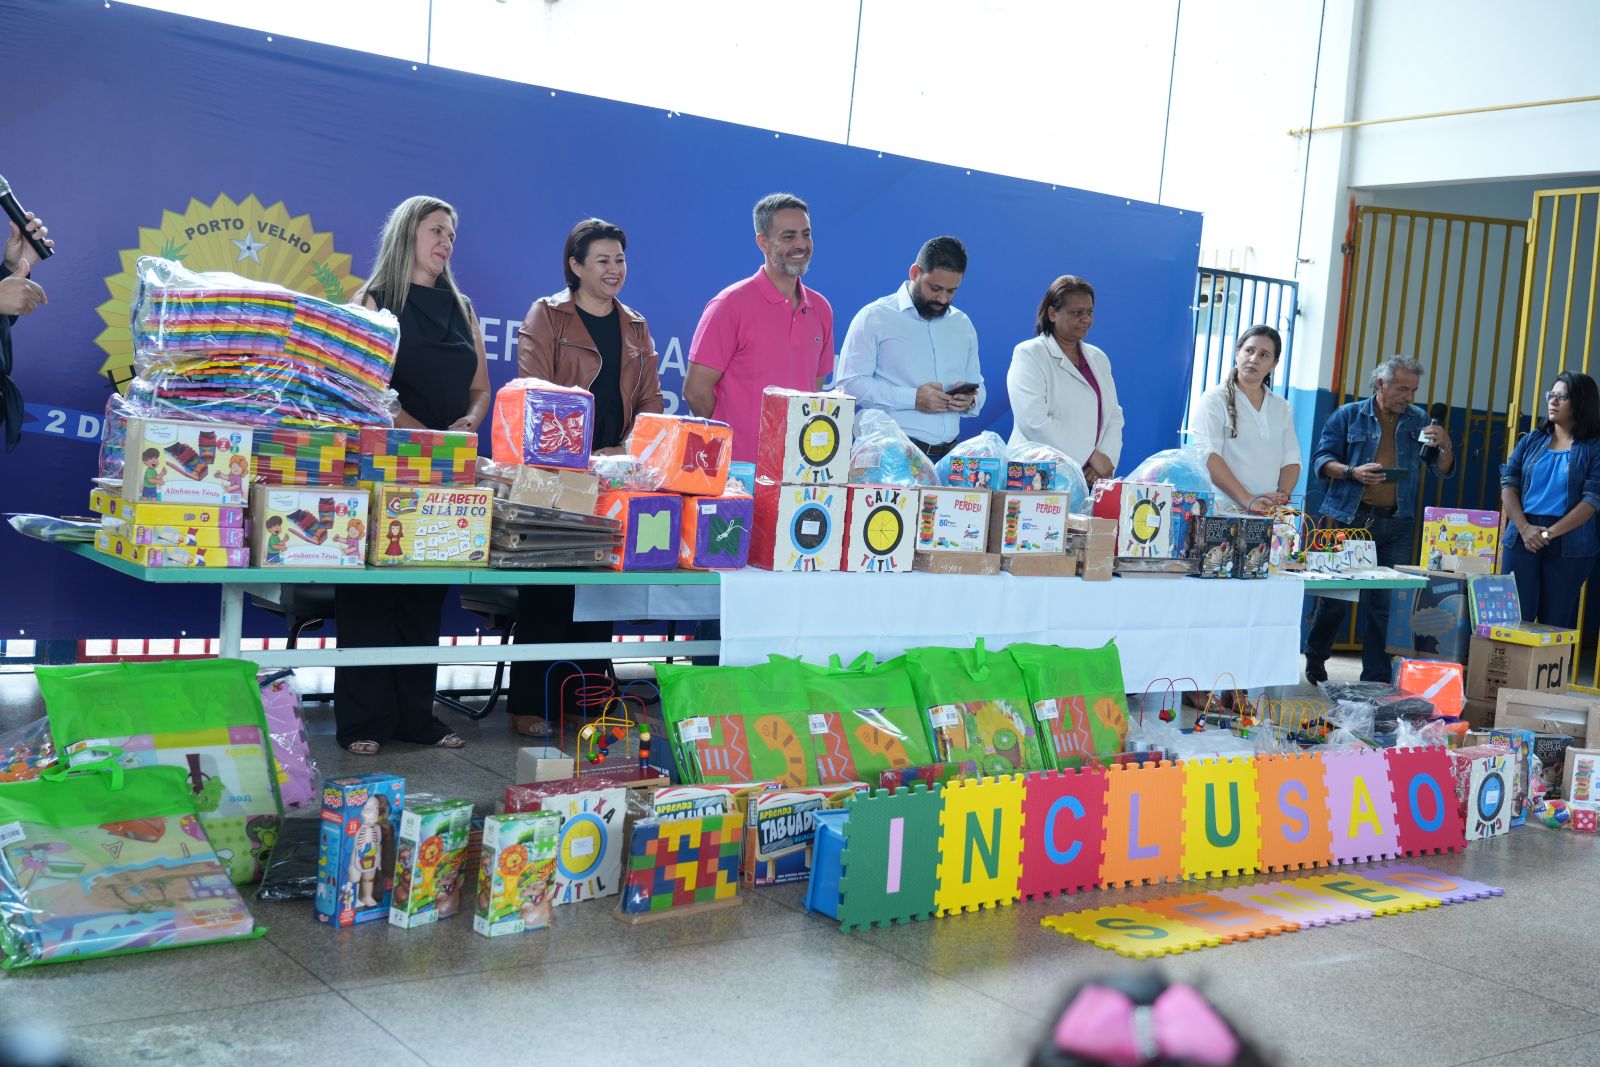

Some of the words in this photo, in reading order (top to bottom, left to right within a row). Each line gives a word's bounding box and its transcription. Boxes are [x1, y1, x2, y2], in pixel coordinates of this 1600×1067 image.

[185, 217, 244, 240] PORTO
[256, 220, 311, 254] VELHO
[801, 399, 841, 419] CAIXA
[44, 409, 66, 434] 2
[77, 414, 107, 441] D
[795, 463, 834, 483] TÁTIL
[425, 492, 488, 505] ALFABETO
[793, 487, 834, 508] CAIXA
[864, 489, 907, 510] CAIXA
[954, 499, 982, 513] PERDEU
[1035, 502, 1062, 515] PERDEU
[860, 553, 898, 572] TÁTIL
[656, 801, 693, 814] APRENDA
[759, 806, 793, 820] APRENDA
[886, 771, 1446, 894] INCLUSAO
[552, 875, 606, 902] TÁTIL
